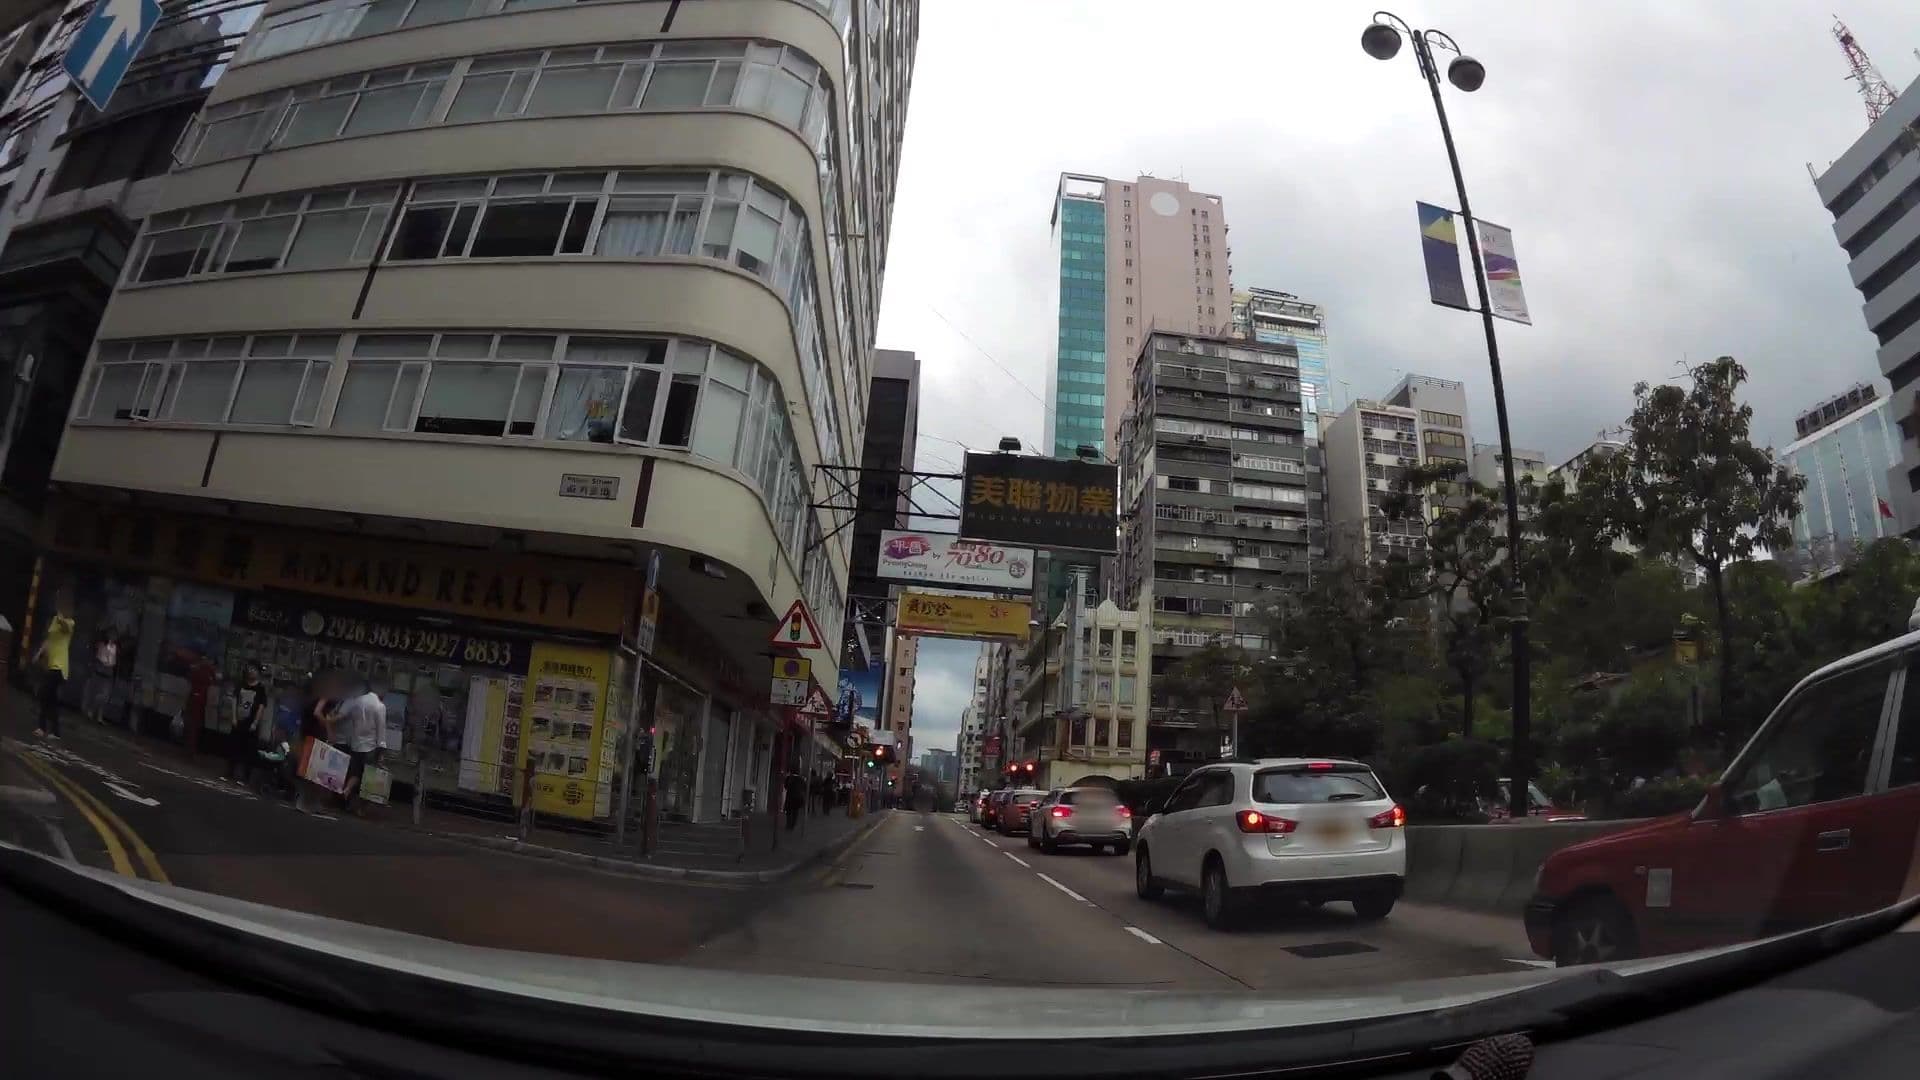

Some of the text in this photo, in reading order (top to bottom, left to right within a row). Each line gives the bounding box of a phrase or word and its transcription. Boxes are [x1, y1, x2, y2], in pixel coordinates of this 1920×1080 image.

[970, 474, 1113, 516] 美聯物業
[932, 552, 941, 560] by
[281, 552, 584, 618] MIDLAND REALTY
[326, 615, 512, 667] 2926 3833 2927 8833
